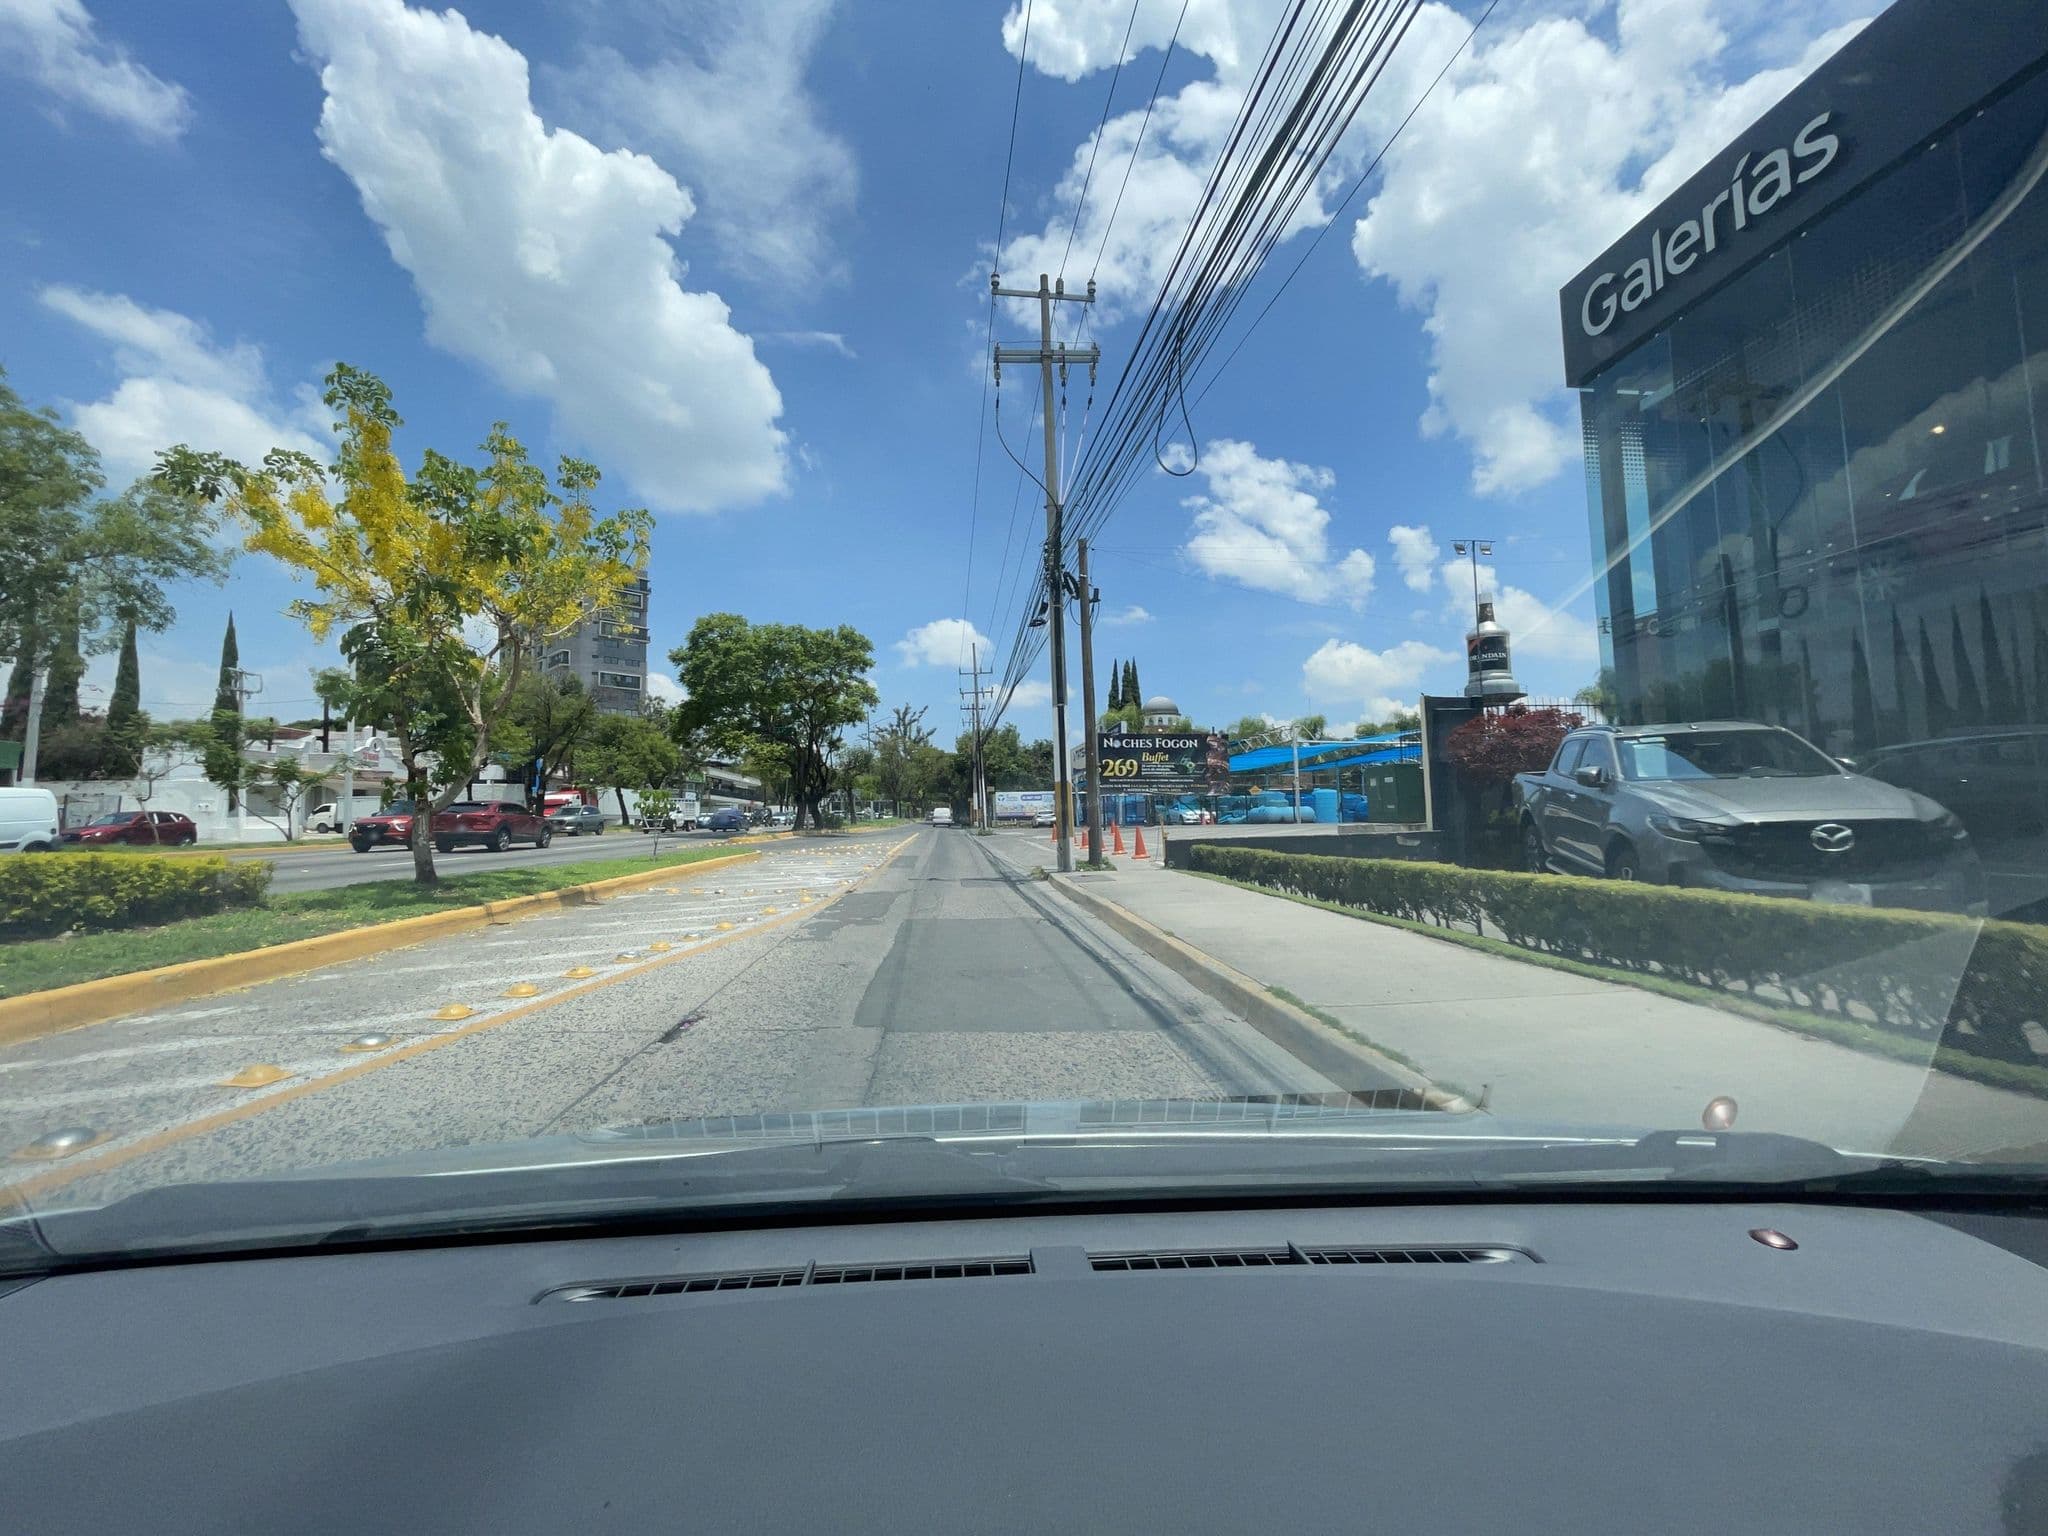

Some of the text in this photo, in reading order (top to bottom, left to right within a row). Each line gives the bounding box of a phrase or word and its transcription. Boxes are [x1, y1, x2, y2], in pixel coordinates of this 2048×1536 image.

[1581, 111, 1839, 337] Galerías
[1469, 652, 1507, 662] ORNDAIN
[1155, 737, 1198, 749] FOGON
[1141, 751, 1169, 764] Buffet
